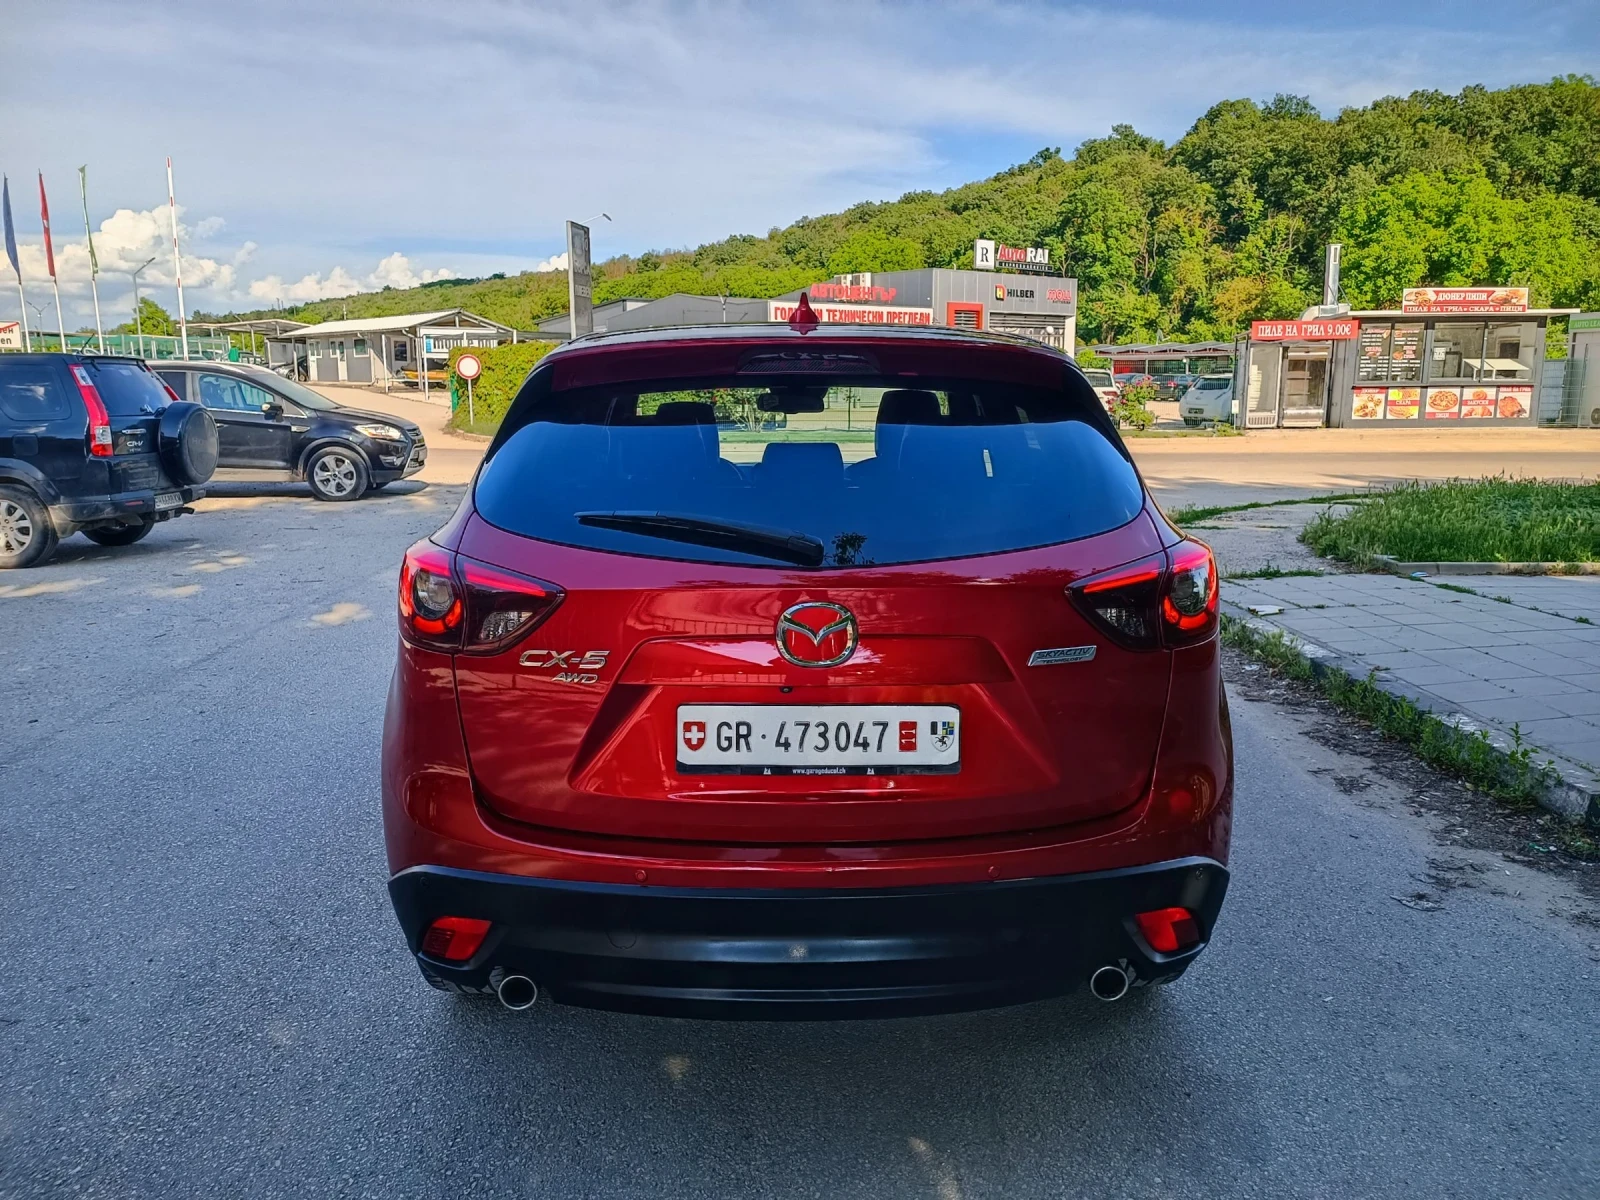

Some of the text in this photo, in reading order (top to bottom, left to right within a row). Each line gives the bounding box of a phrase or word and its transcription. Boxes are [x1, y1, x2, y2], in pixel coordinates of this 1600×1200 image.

[980, 246, 990, 263] R
[1007, 288, 1035, 299] HILBER
[826, 309, 884, 323] ТЕХНИЧЕСКИ
[886, 311, 931, 325] ПРЕГЛЕДИ
[1257, 323, 1352, 337] ПИЛЕ НА ГРИЛ 9.00€
[519, 649, 610, 669] CX-5
[1036, 647, 1091, 659] SKYACTIV
[552, 672, 598, 684] AWD
[716, 720, 889, 752] GR 473047
